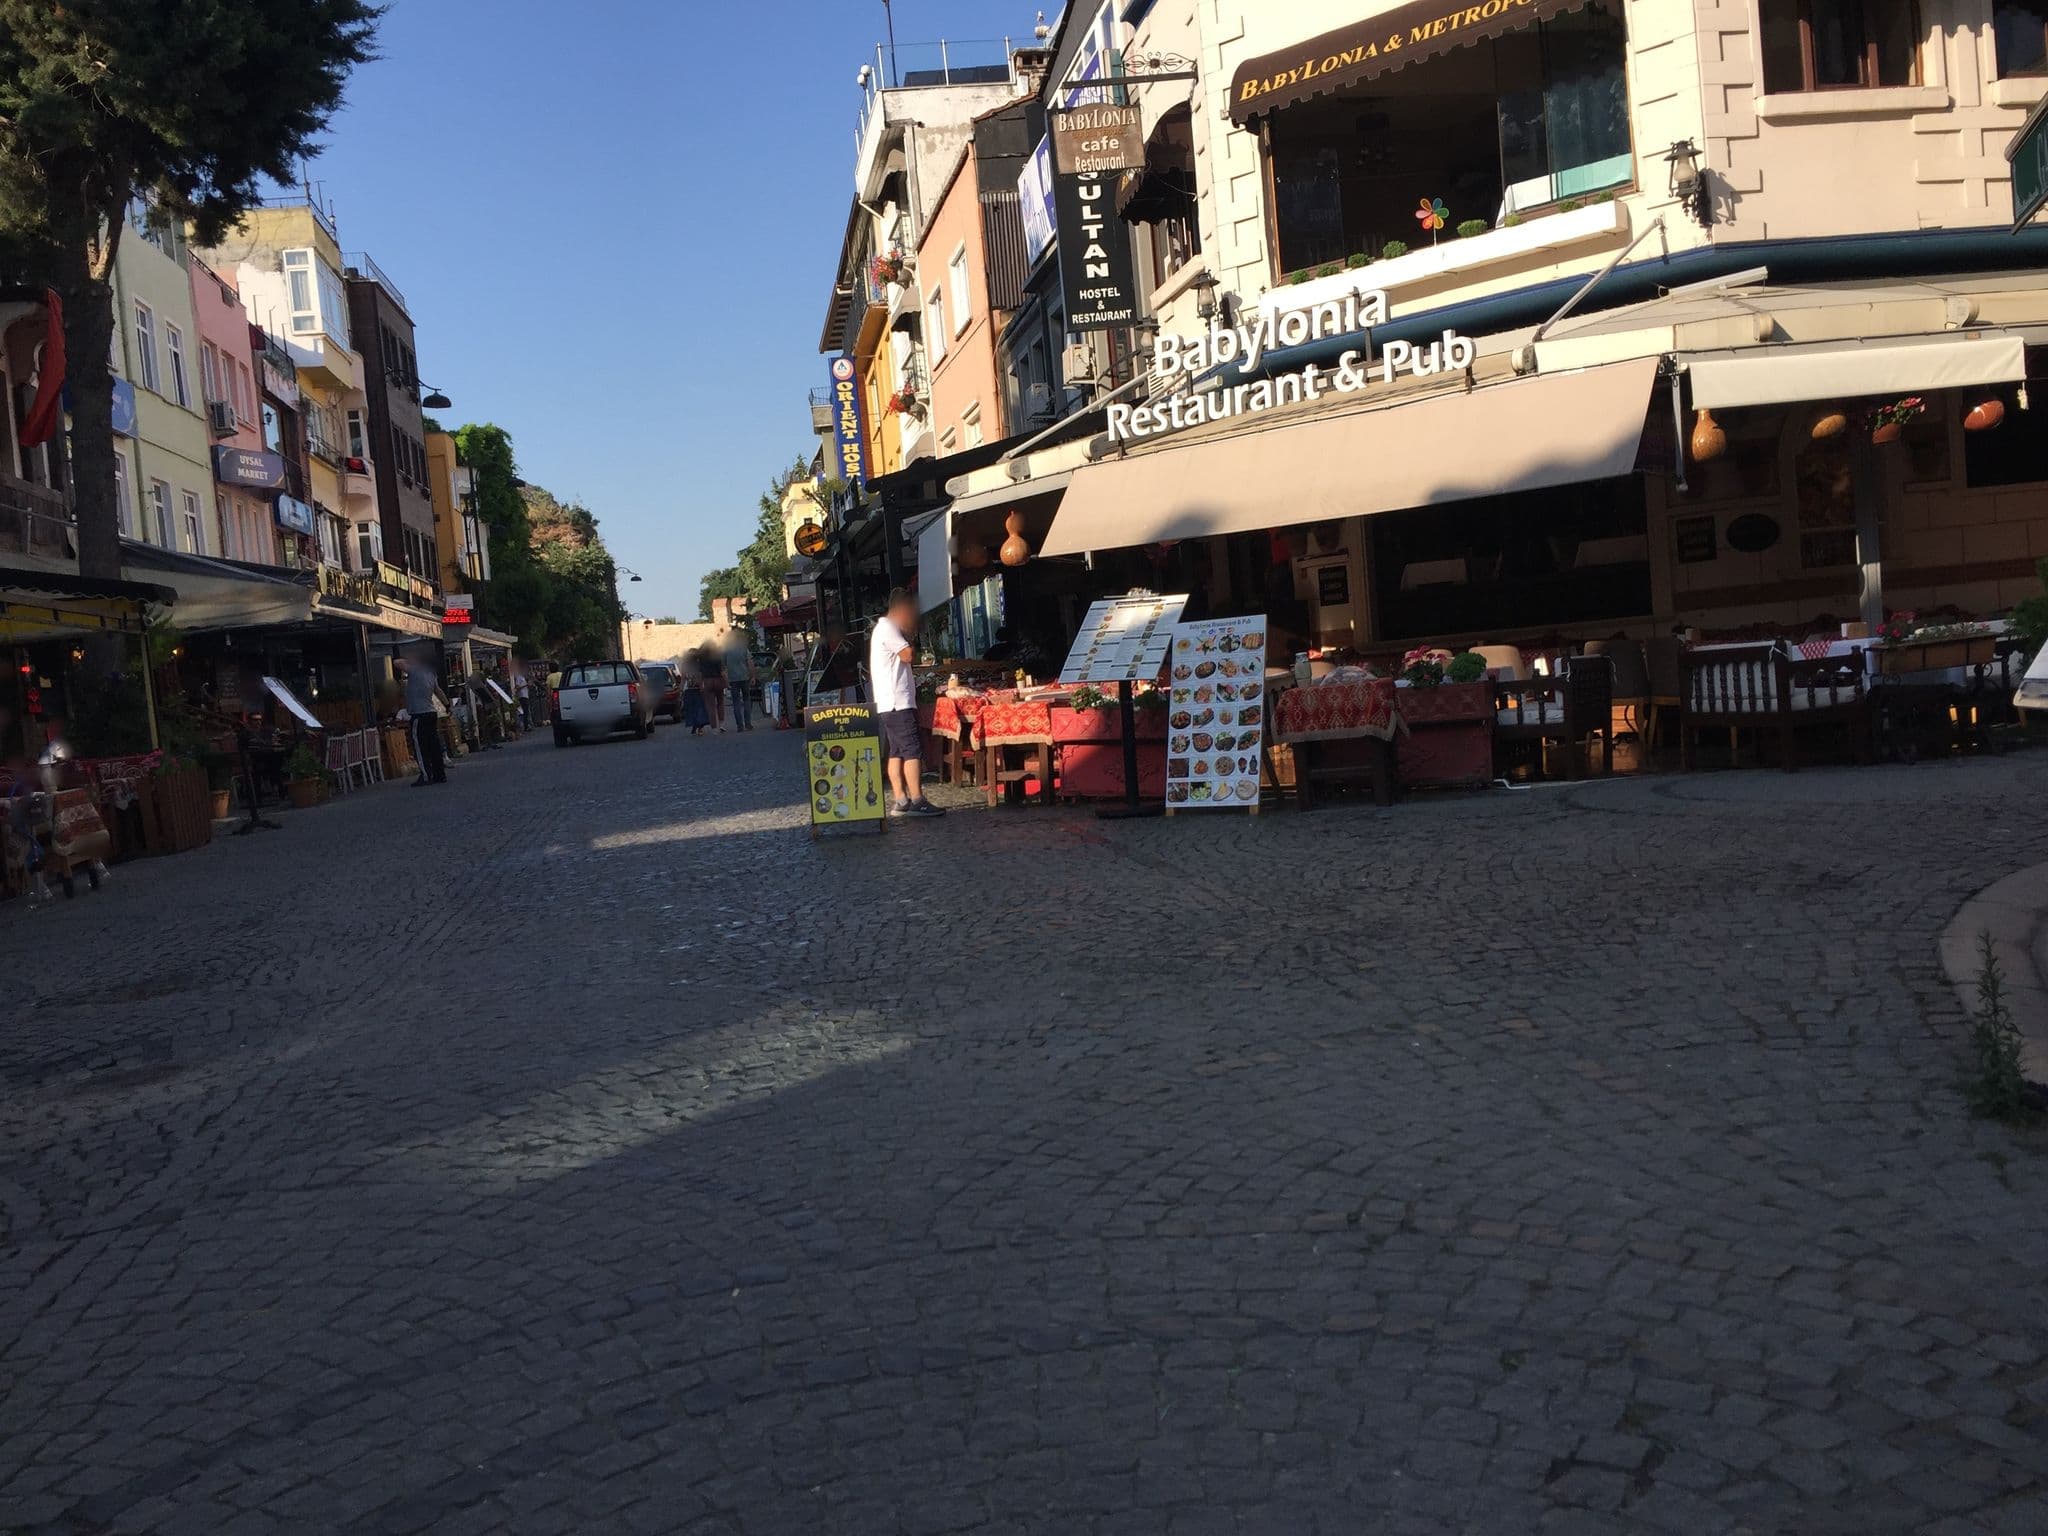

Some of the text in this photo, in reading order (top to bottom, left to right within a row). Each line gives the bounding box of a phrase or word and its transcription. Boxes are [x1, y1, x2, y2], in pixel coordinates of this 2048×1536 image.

[1239, 0, 1533, 102] BABYLONIA & METROP
[1059, 107, 1136, 132] BABYLONIA
[1081, 135, 1120, 152] cafe
[1075, 152, 1126, 173] Restaurant
[1079, 286, 1121, 300] HOSTEL
[1097, 300, 1105, 310] &
[1072, 309, 1132, 325] RESTAURANT
[1154, 288, 1391, 377] Babylonia
[1106, 329, 1477, 442] Restaurant & Pub
[836, 382, 858, 439] ORIENT
[239, 455, 265, 467] UYSAL
[237, 468, 269, 481] MARKET
[812, 707, 869, 722] BABYLONIA
[821, 731, 849, 741] SHISHA
